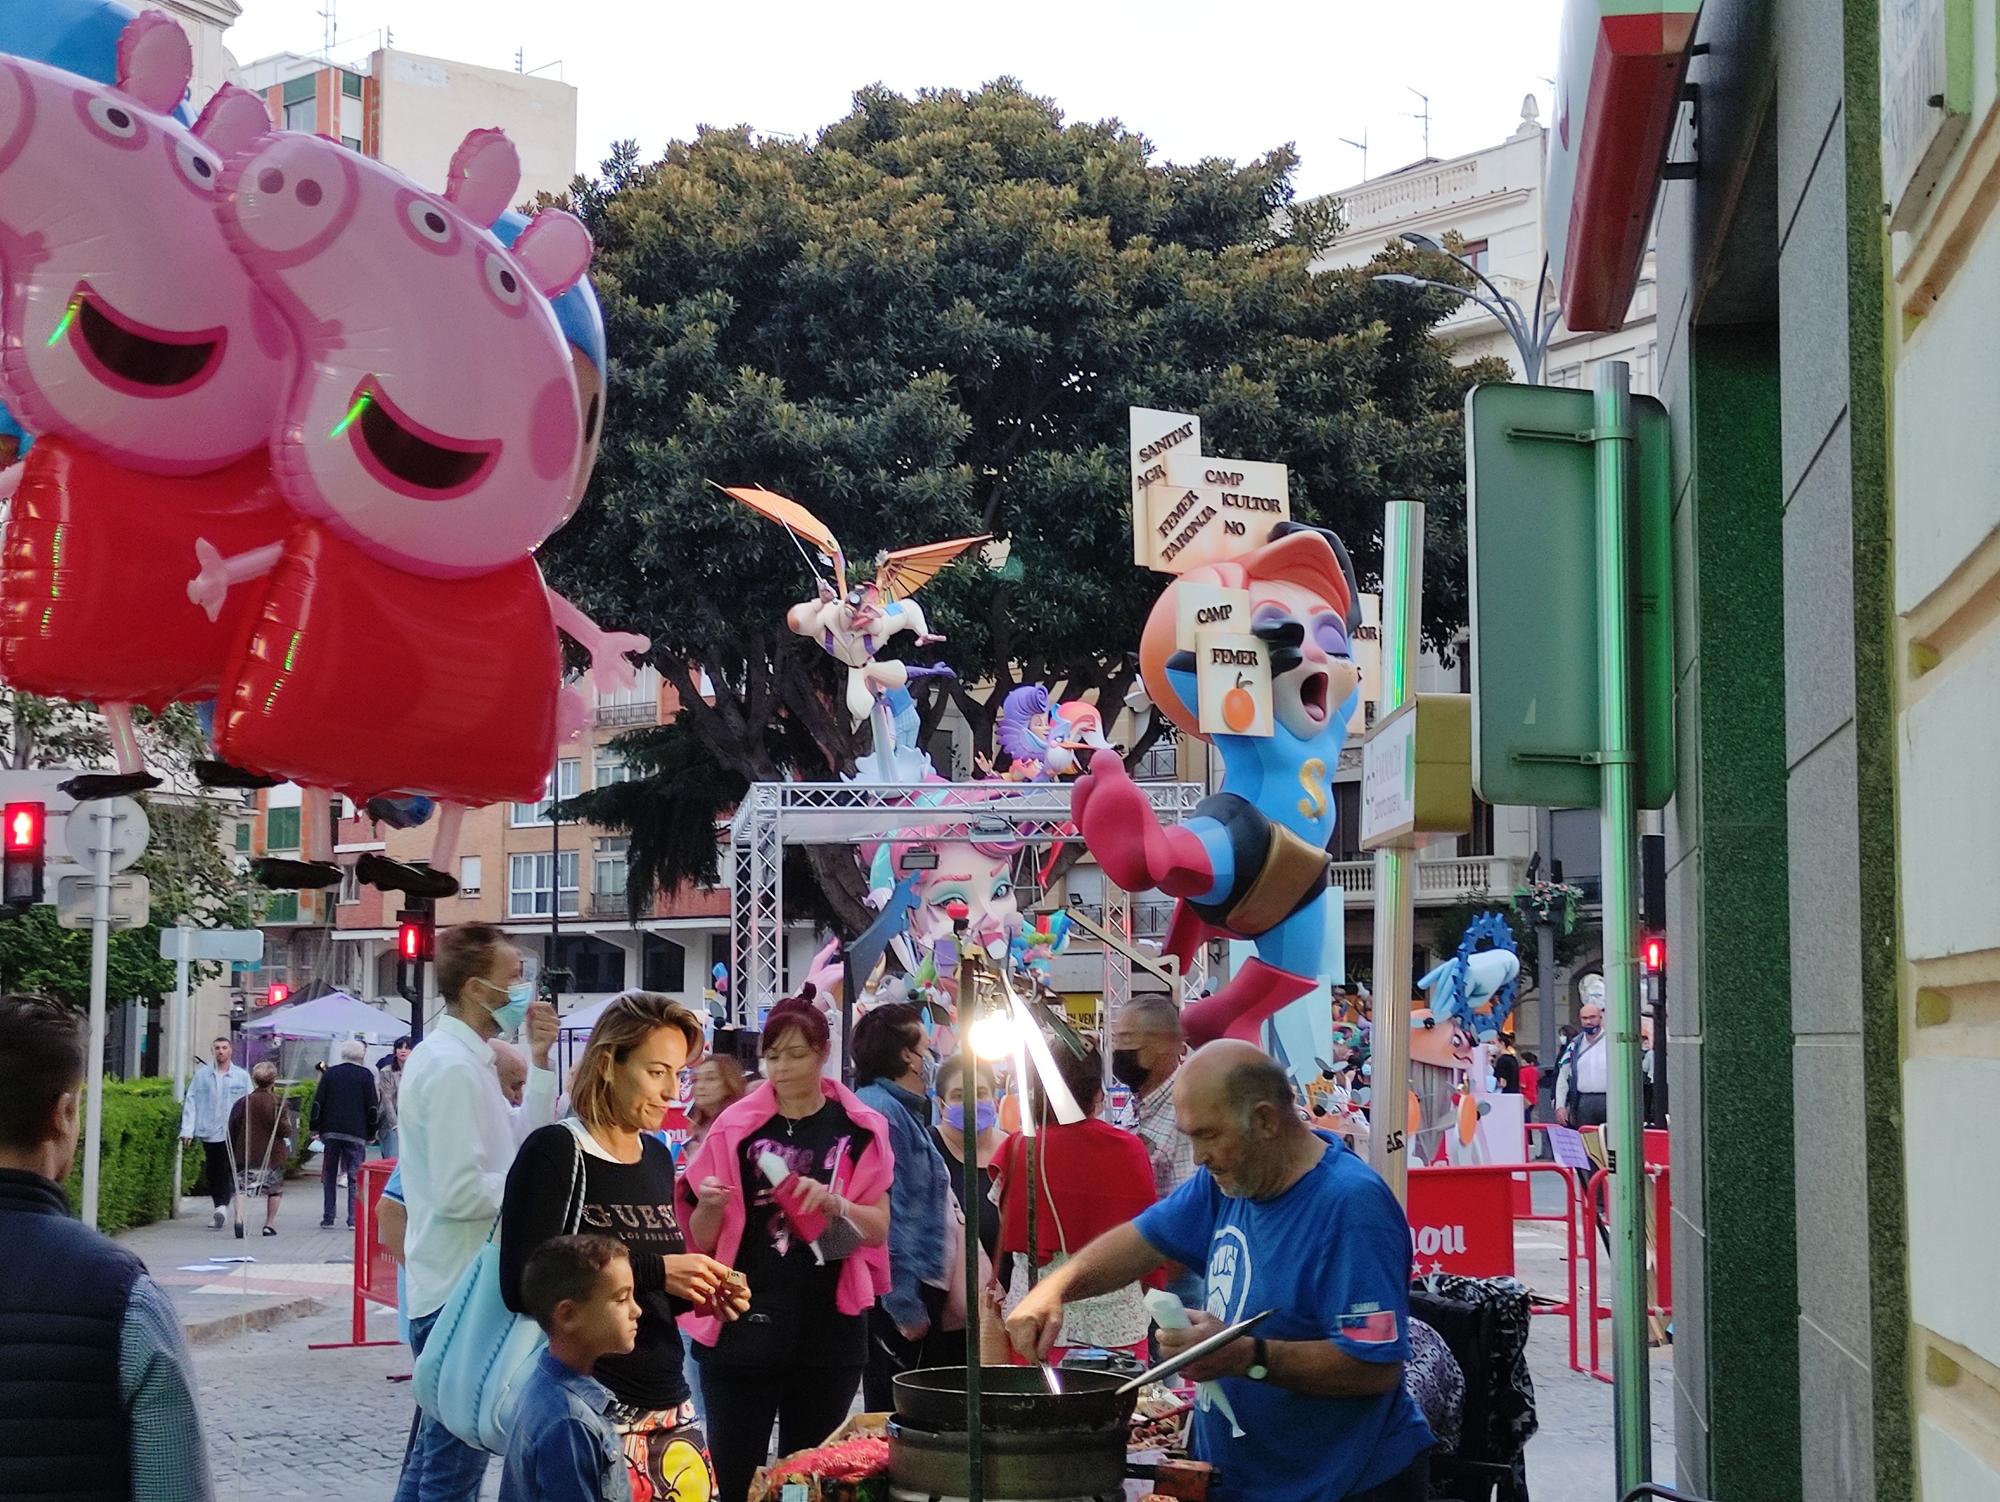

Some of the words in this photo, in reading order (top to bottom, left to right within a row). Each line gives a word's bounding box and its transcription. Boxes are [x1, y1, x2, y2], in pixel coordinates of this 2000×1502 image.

[1138, 421, 1194, 463] SANITAT
[1137, 464, 1167, 489] AGR
[1205, 469, 1244, 486] CAMP
[1221, 491, 1282, 513] ICULTOR
[1158, 489, 1199, 538] FEMER
[1161, 505, 1217, 562] TARONJA
[1224, 519, 1246, 536] NO
[1197, 604, 1233, 624] CAMP
[1211, 647, 1259, 666] FEMER
